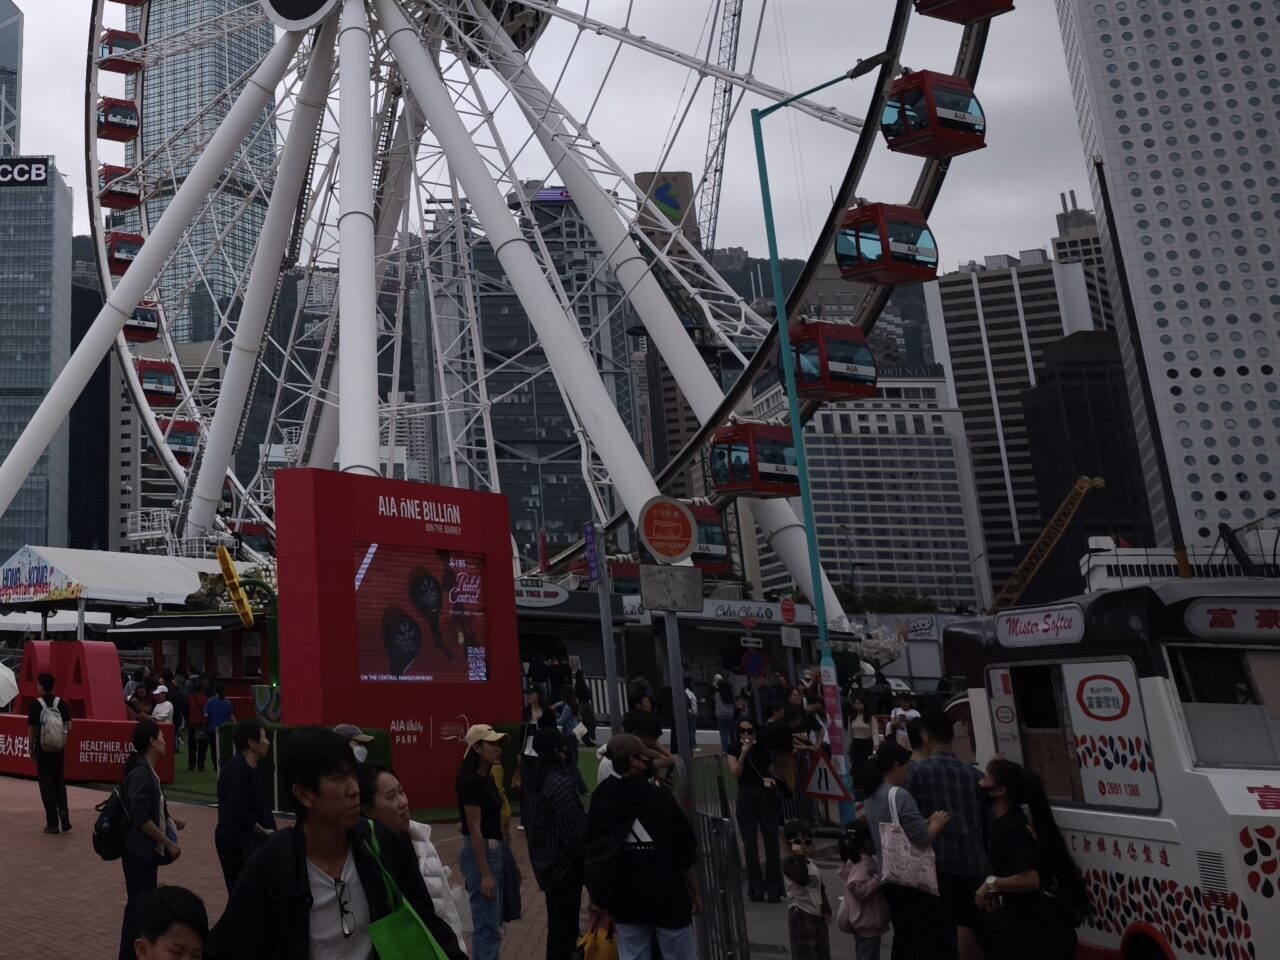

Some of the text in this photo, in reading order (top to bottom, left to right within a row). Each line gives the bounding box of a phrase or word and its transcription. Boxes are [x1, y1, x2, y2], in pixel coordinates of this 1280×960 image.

[954, 112, 967, 121] AIA
[907, 245, 920, 255] AIA
[846, 364, 859, 373] AIA
[775, 465, 788, 473] AIA
[378, 495, 398, 517] AIA
[435, 524, 444, 533] THE
[444, 525, 462, 535] JOURNEY
[698, 544, 710, 552] AIA
[2, 565, 48, 586] HONG KONG
[1005, 613, 1073, 638] Mister Softee
[13, 640, 128, 720] AIA
[390, 720, 405, 732] AIA
[395, 734, 418, 745] PARK
[80, 740, 123, 753] HEALTHIER,
[80, 751, 108, 763] BETTER
[1106, 782, 1123, 796] 2691
